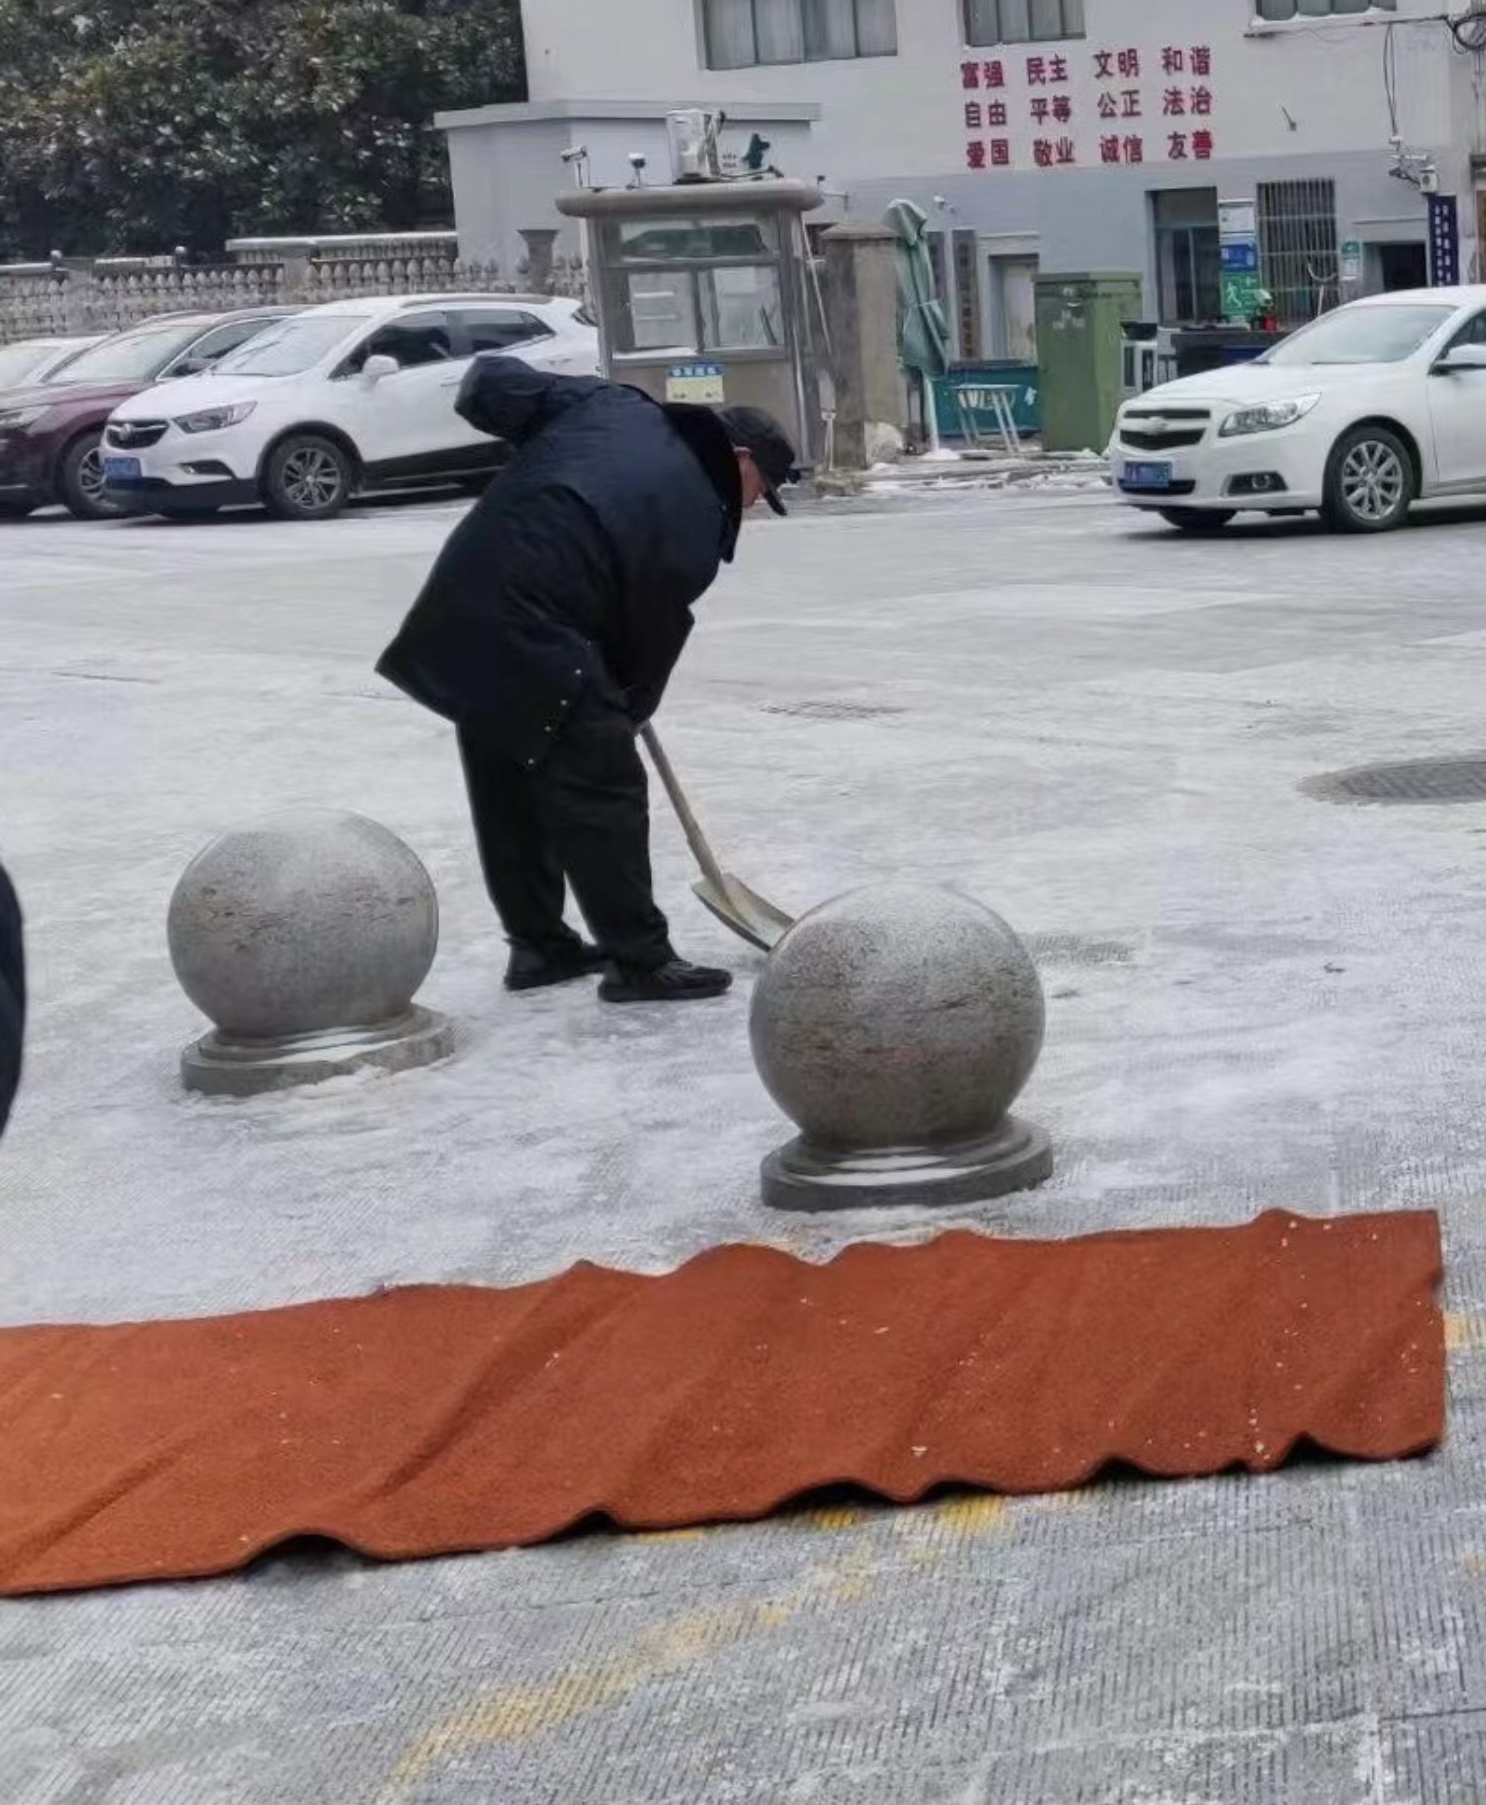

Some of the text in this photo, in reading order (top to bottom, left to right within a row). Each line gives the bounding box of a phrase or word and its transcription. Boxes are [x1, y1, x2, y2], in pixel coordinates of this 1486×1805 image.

[960, 46, 1211, 89] 富强 民主 文明 和谐
[964, 85, 1212, 128] 自由 平等 公正 法治
[965, 129, 1213, 169] 爱国 敬业 诚信 友善
